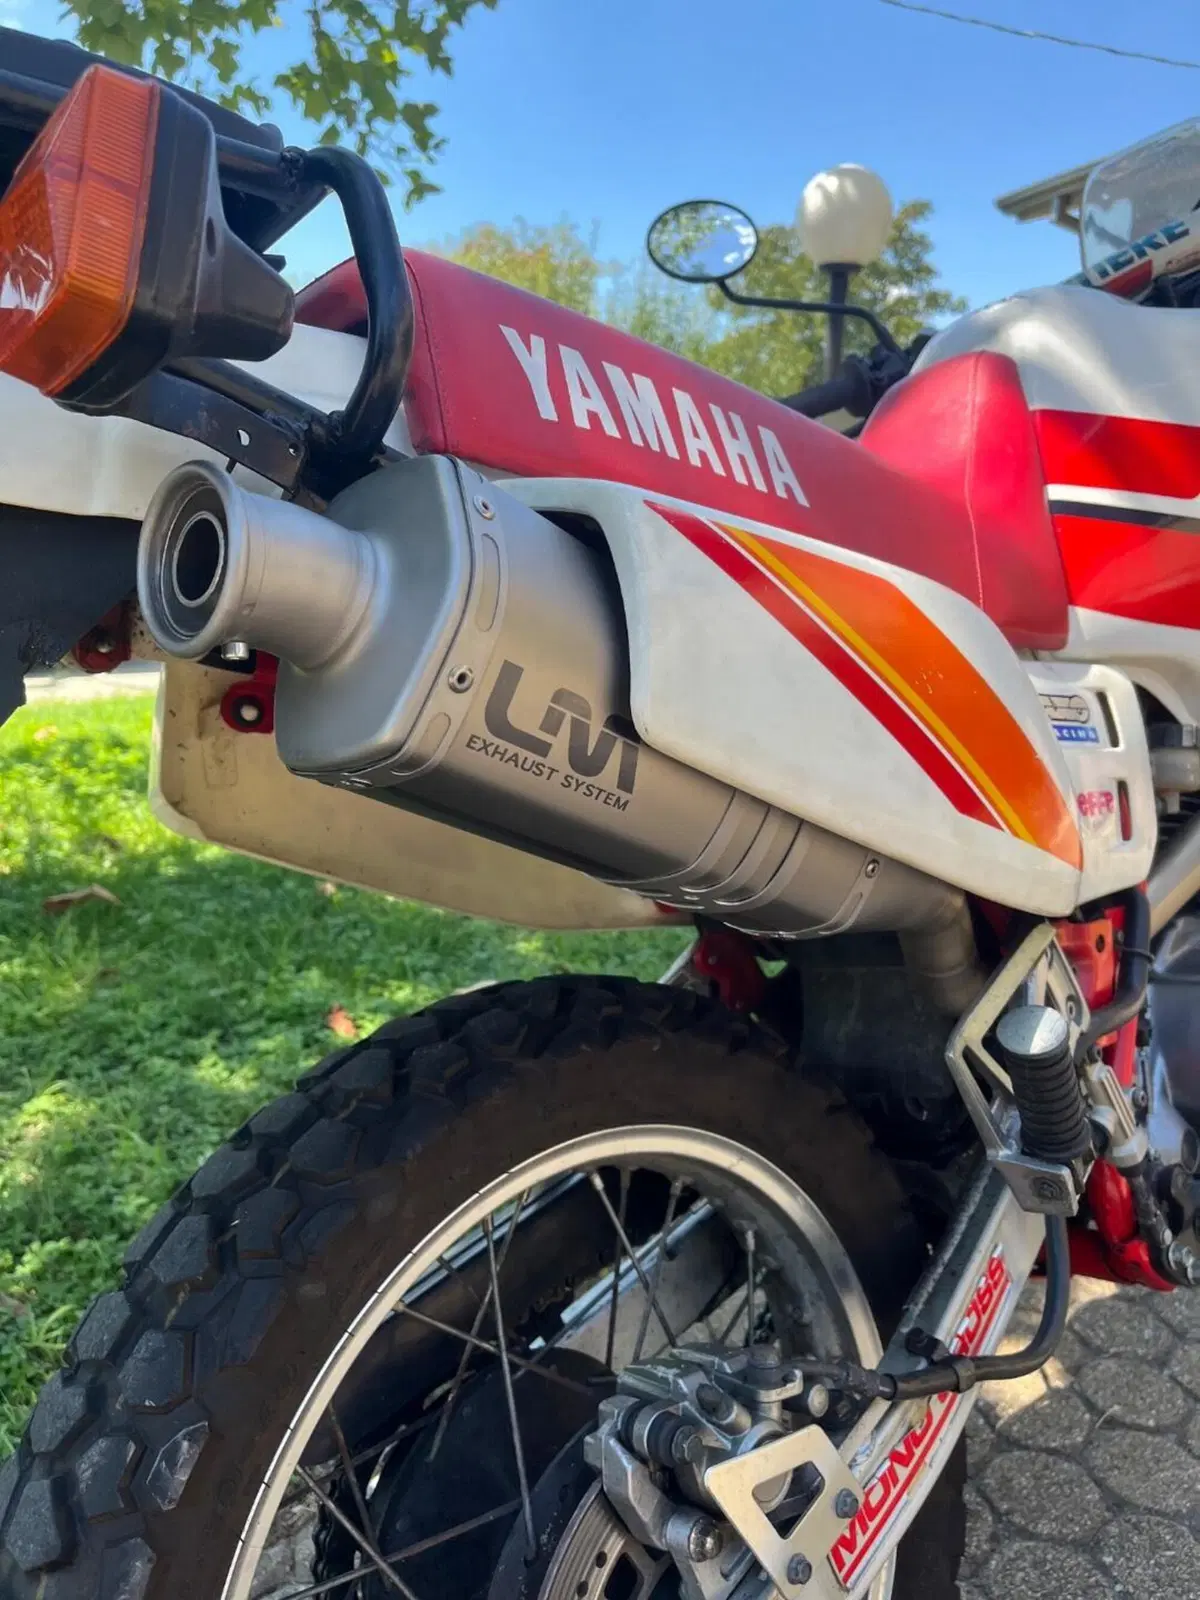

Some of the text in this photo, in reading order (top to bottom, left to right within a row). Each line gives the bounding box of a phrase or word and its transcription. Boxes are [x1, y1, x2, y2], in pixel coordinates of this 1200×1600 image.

[498, 324, 810, 508] YAMAHA
[465, 734, 630, 812] EXHAUST SYSTEM
